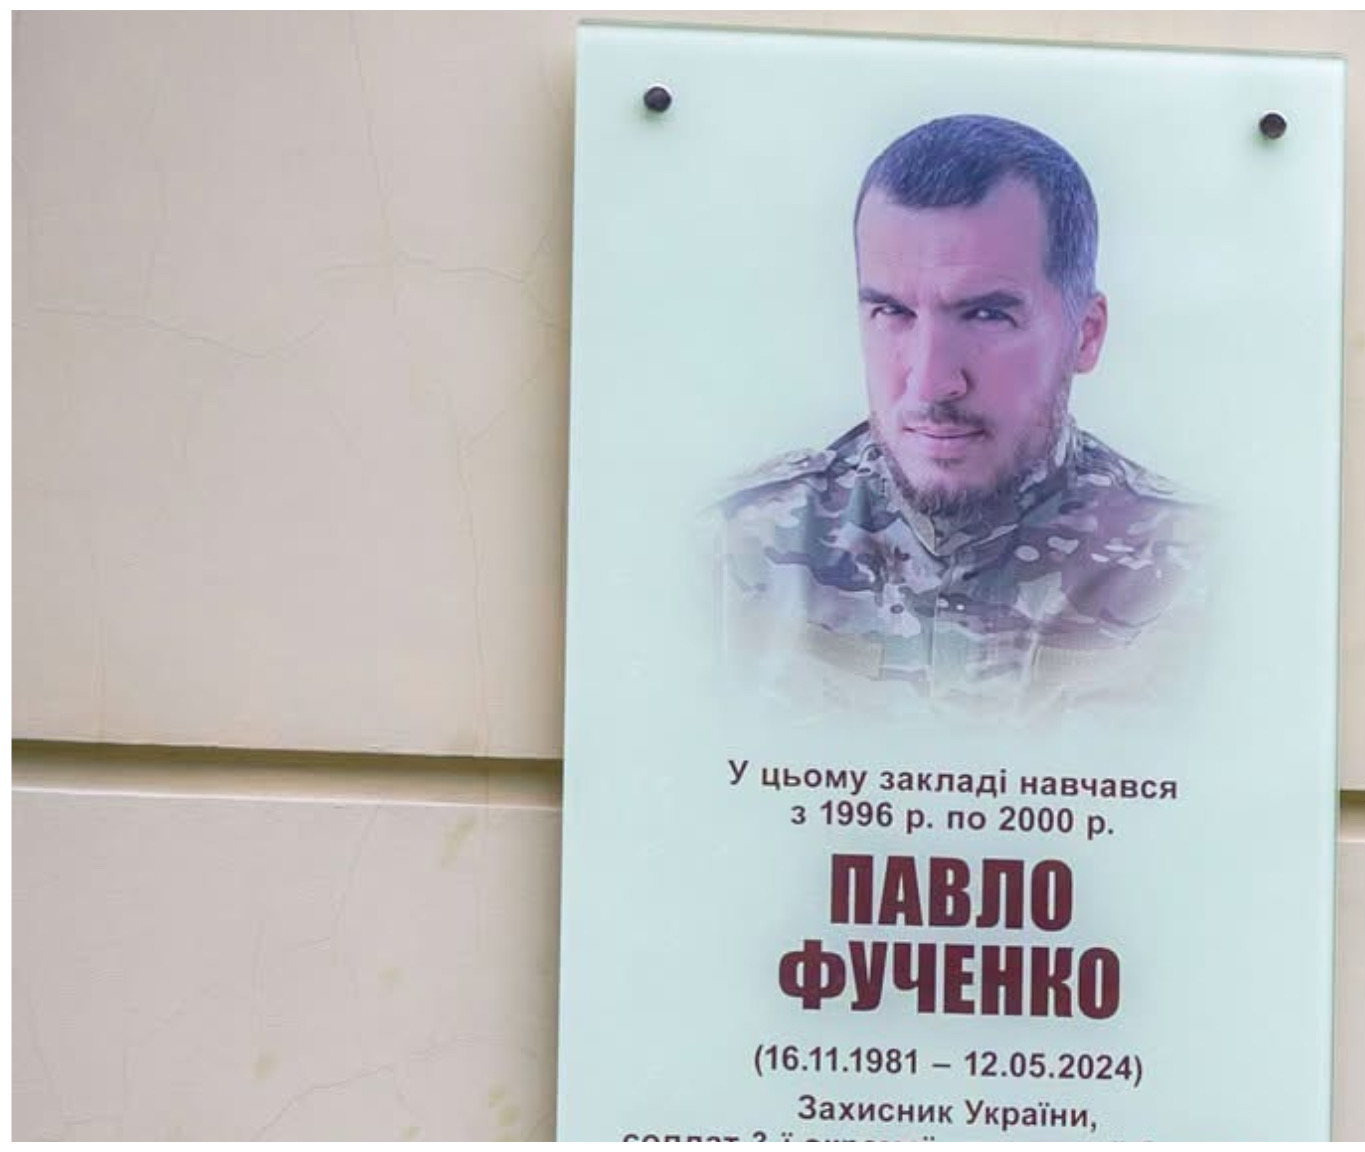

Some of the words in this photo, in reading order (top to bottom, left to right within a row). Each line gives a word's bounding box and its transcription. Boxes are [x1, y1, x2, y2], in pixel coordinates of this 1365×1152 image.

[728, 759, 749, 786] У
[761, 767, 868, 796] цьому
[879, 768, 1007, 797] закладі
[1020, 775, 1177, 800] навчався
[790, 805, 807, 825] з
[820, 799, 894, 828] 1996
[906, 809, 933, 835] р.
[947, 810, 987, 831] по
[998, 805, 1074, 834] 2000
[1087, 815, 1114, 841] р.
[830, 853, 1073, 933] ПАВЛО
[778, 938, 1121, 1020] ФУЧЕНКО
[754, 1044, 917, 1077] (16.11.1981
[964, 1050, 1143, 1088] 12.05.2024)
[797, 1094, 954, 1124] Захисник
[964, 1099, 1097, 1133] України,
